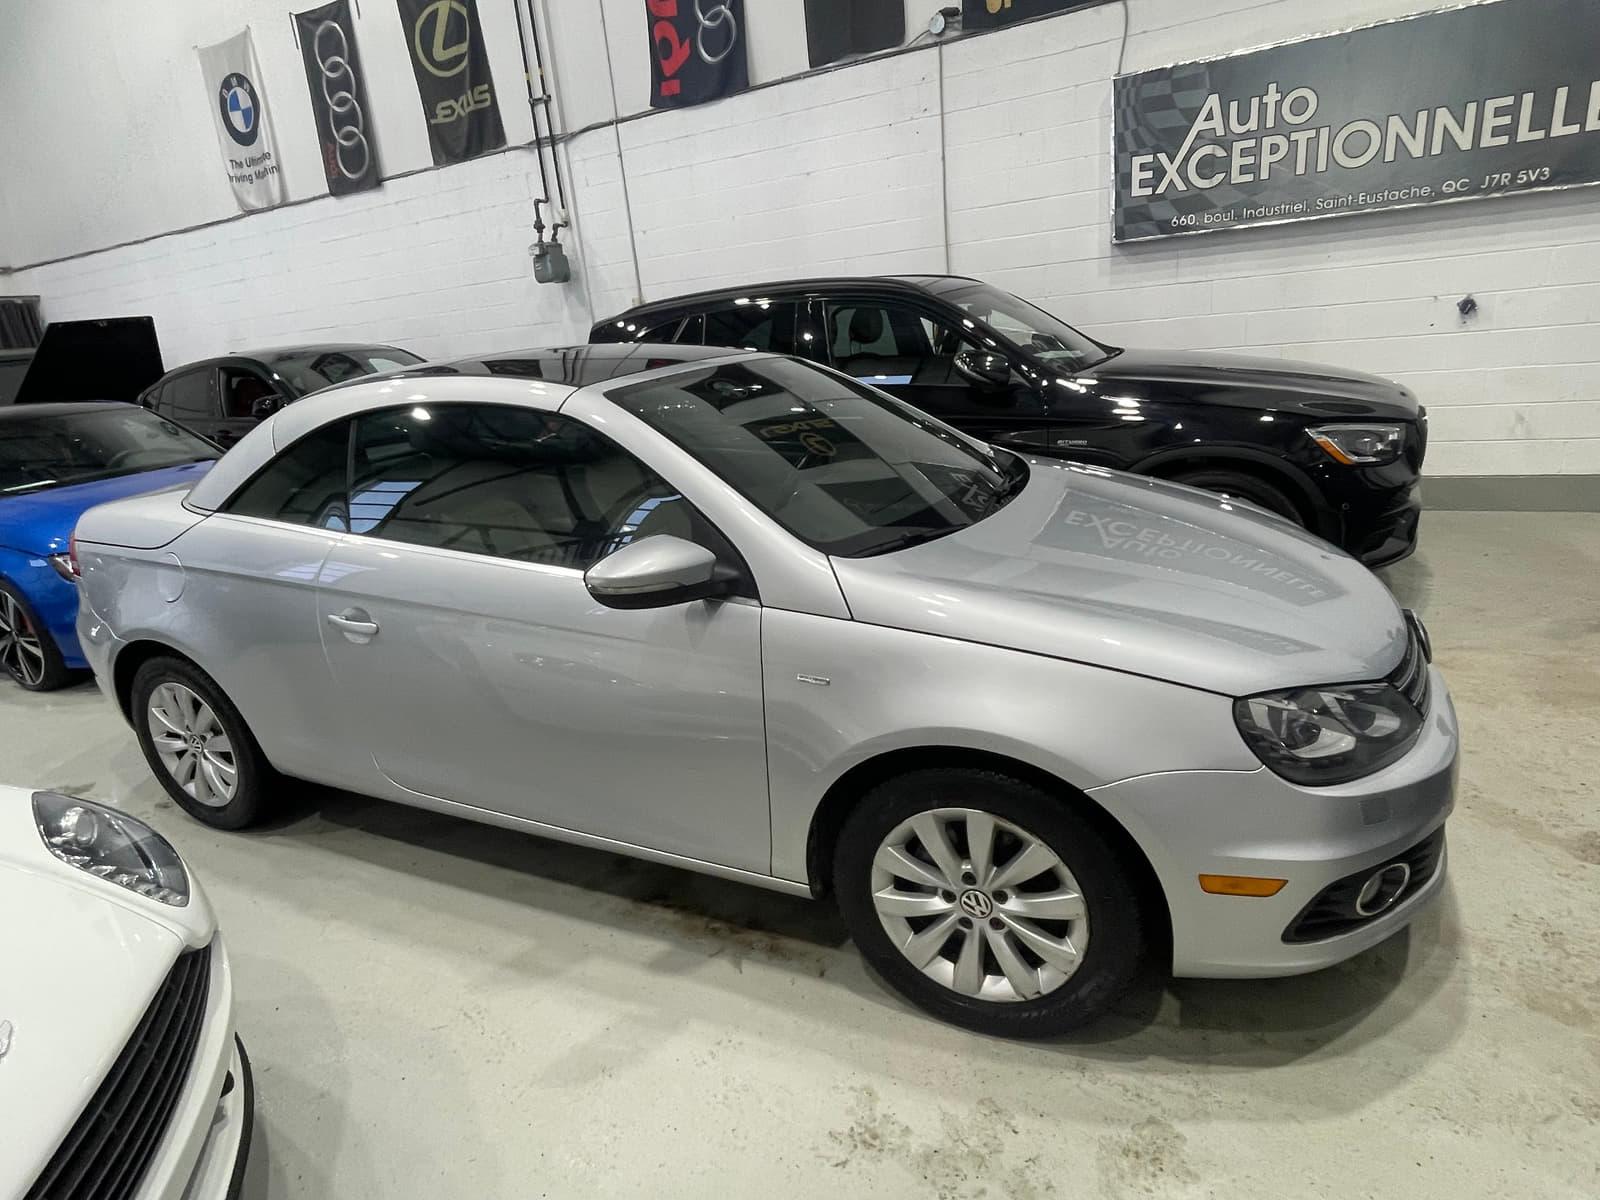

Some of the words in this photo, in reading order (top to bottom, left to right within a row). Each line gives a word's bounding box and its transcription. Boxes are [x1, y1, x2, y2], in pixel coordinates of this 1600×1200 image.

[430, 83, 492, 125] LEXUS
[1196, 82, 1319, 138] Auto
[229, 159, 244, 169] The
[1204, 208, 1238, 224] boul.
[1243, 199, 1310, 219] Industriel,
[1315, 185, 1436, 210] Saint-Eustache,
[1441, 178, 1470, 194] QC
[1480, 172, 1511, 189] J7R
[1516, 166, 1550, 184] 5V3
